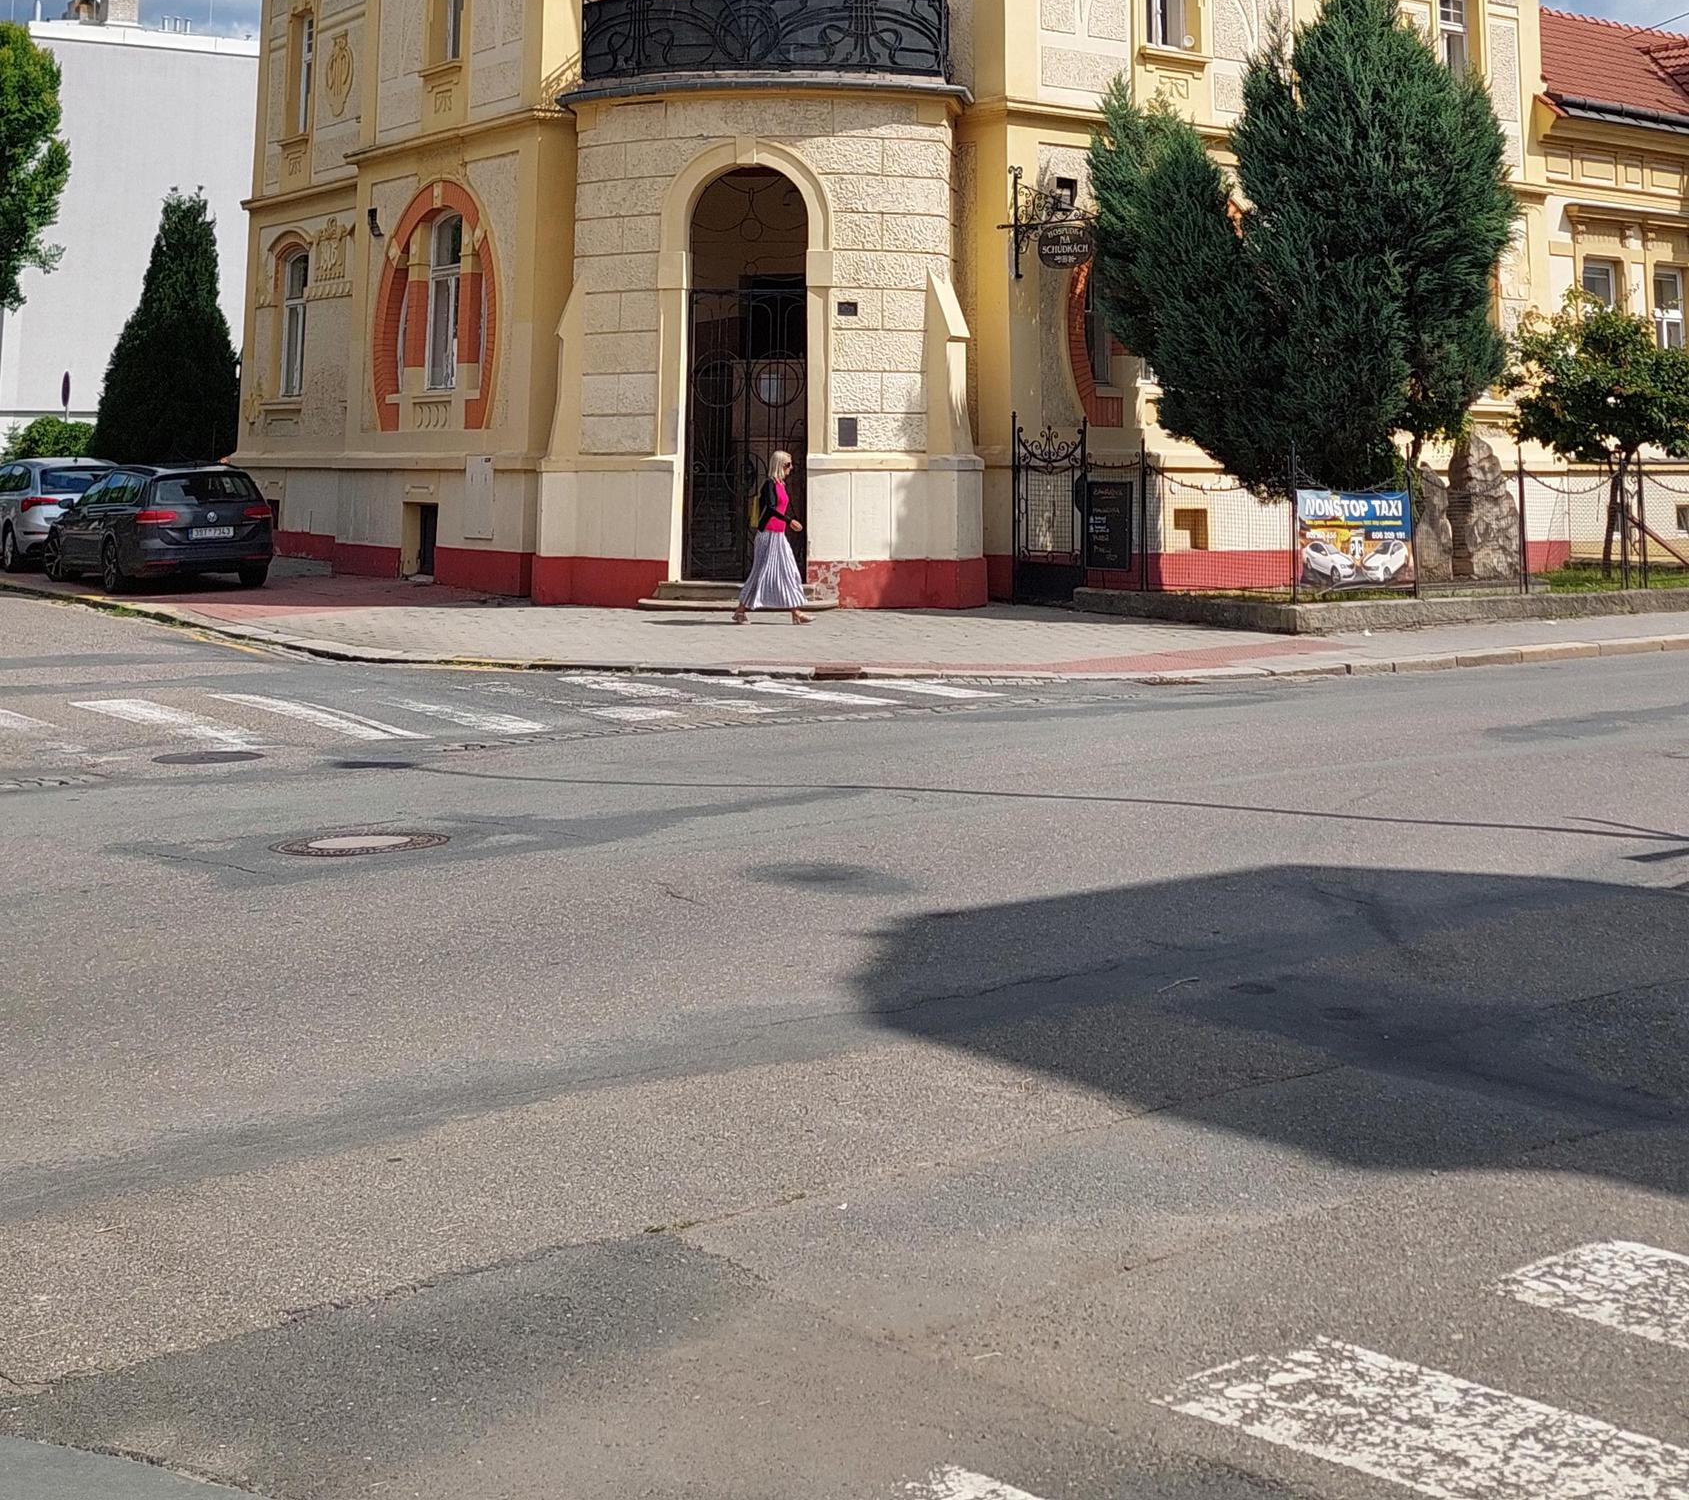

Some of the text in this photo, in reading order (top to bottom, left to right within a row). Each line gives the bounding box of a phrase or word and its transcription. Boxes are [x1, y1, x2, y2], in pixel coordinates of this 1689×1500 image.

[1060, 235, 1071, 244] NA
[1305, 498, 1402, 517] NONSTOP TAXI
